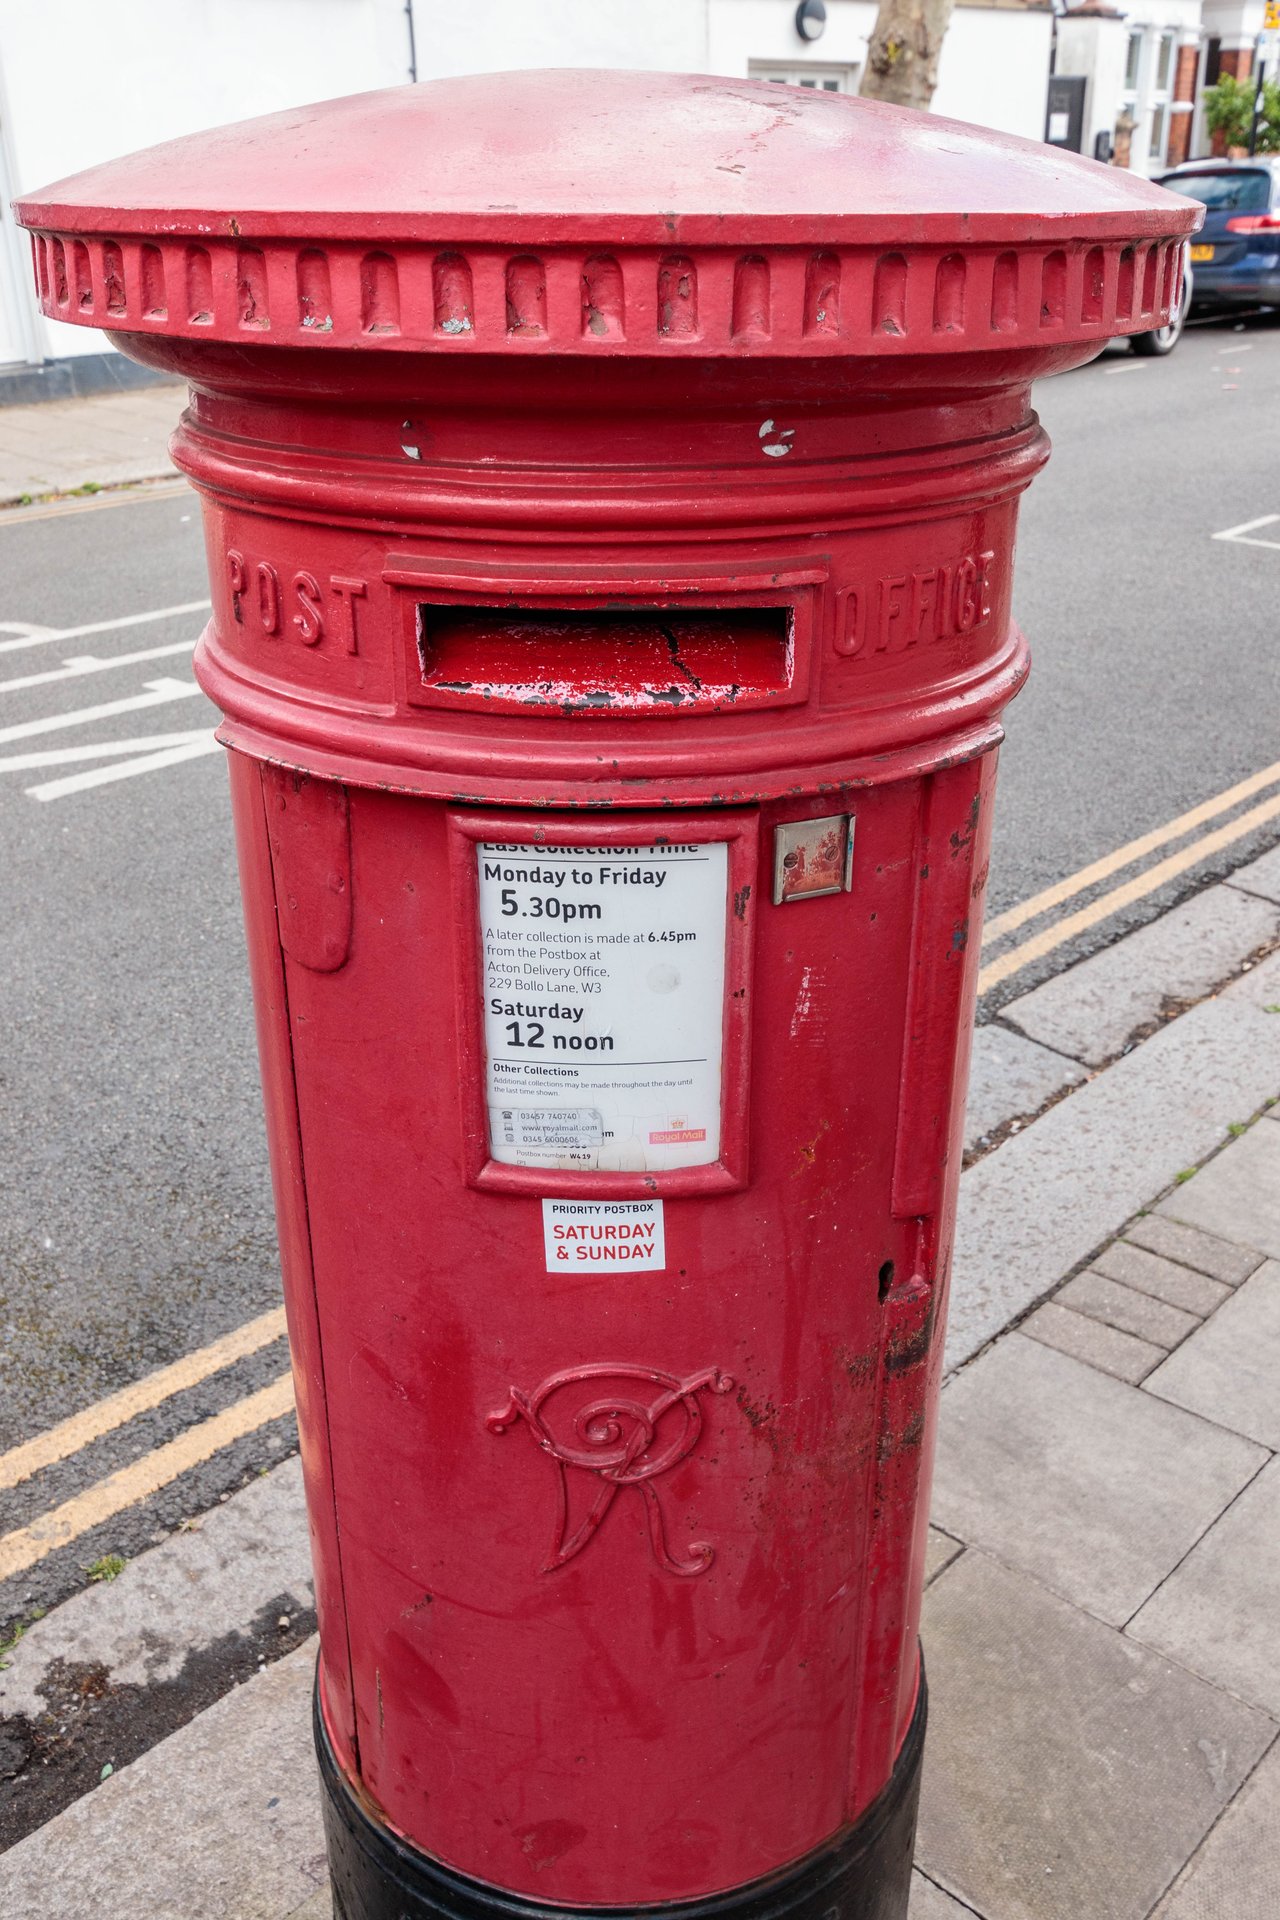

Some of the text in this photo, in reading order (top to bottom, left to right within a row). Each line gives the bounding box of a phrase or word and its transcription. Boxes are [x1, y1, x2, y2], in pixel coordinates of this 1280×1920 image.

[227, 548, 368, 656] POST
[485, 864, 666, 887] Monday to Friday
[502, 889, 601, 923] 5.30pm
[486, 928, 696, 943] A later collection is made at 6.45pm
[487, 945, 600, 960] from the Postbox at
[488, 961, 609, 978] Acton Delivery Office,
[489, 977, 601, 993] 229 Bollo Lane, W3
[491, 999, 584, 1023] Saturday
[506, 1022, 613, 1050] 12 noon
[494, 1064, 578, 1076] Other Collections
[493, 1077, 526, 1086] Additional
[528, 1080, 563, 1088] collections
[664, 1080, 676, 1088] day
[536, 1089, 560, 1097] shown.
[521, 1112, 577, 1120] 03457 740740
[653, 1131, 703, 1143] Royal Mail
[517, 1150, 540, 1158] Postbox
[553, 1204, 653, 1214] PRIORITY POSTBOX
[554, 1223, 655, 1239] SATURDAY
[557, 1243, 654, 1260] & SUNDAY
